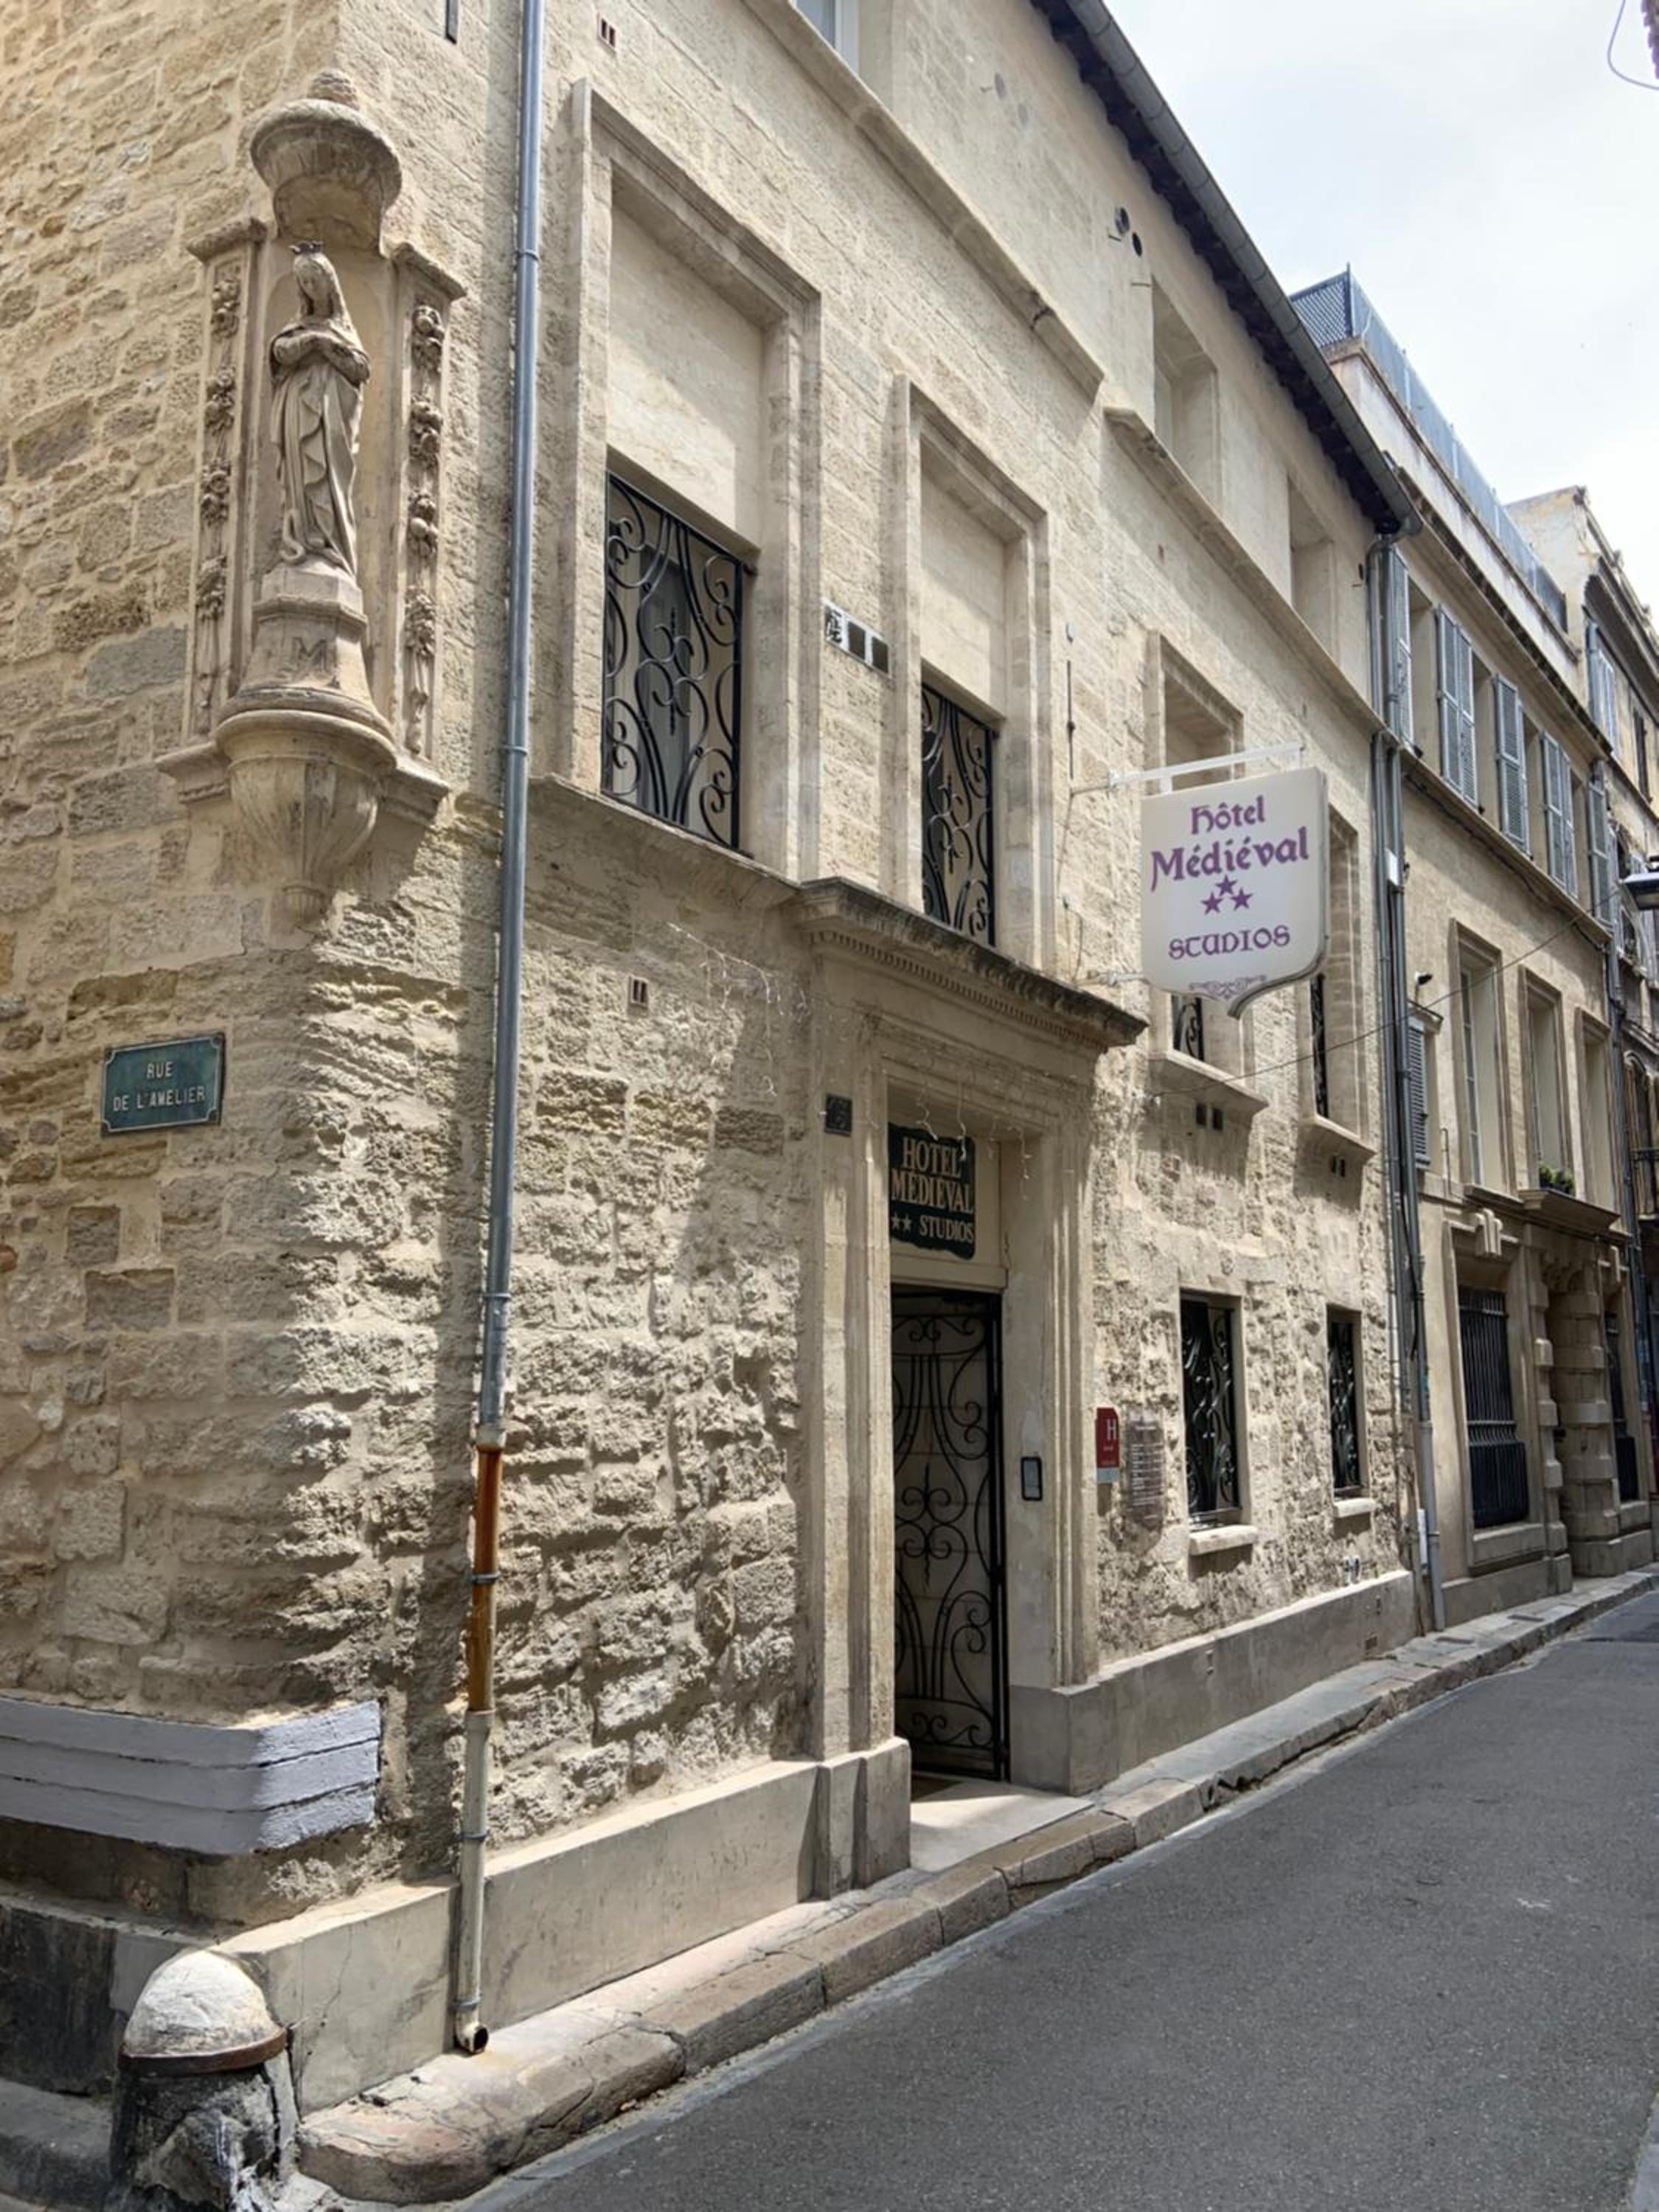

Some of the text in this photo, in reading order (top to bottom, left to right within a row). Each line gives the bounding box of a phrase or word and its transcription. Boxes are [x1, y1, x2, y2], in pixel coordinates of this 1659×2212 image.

[1151, 827, 1310, 892] Médiéval
[1169, 925, 1290, 959] STUDIOS
[147, 1062, 173, 1079] RUE
[113, 1095, 129, 1111] DE
[919, 1214, 974, 1243] STUDIOS
[1107, 1419, 1116, 1439] H
